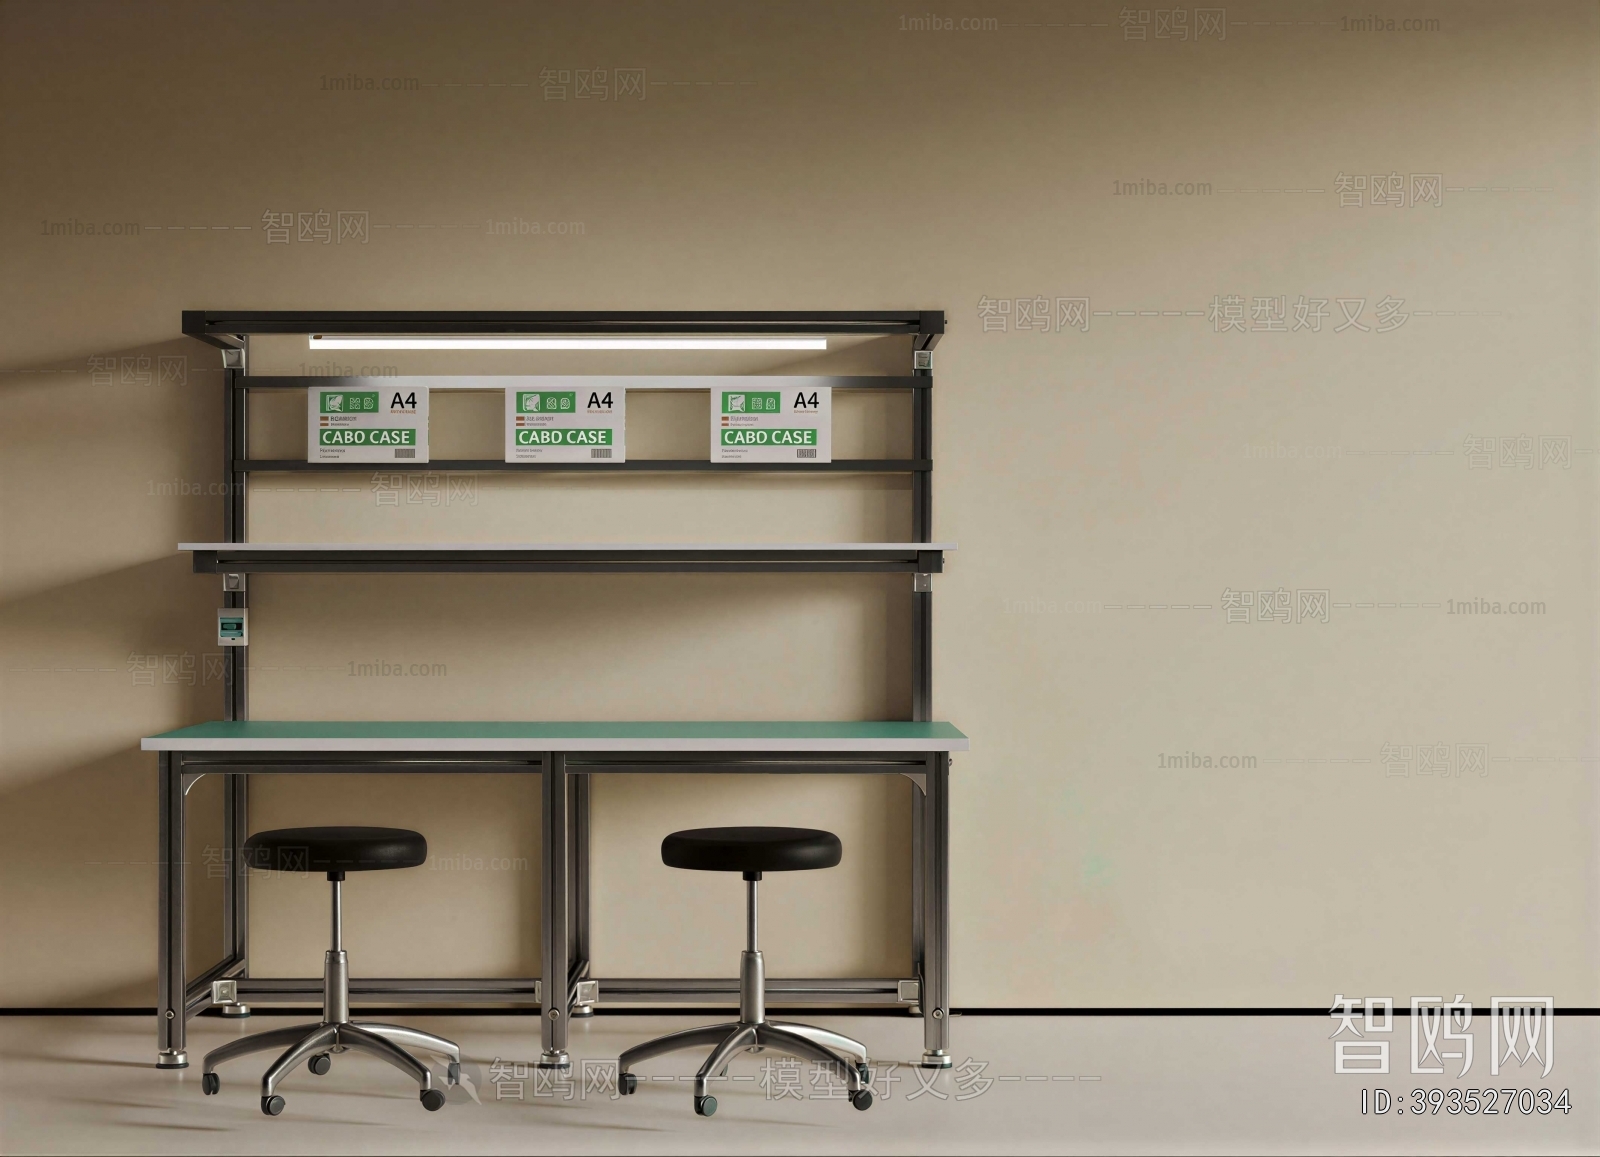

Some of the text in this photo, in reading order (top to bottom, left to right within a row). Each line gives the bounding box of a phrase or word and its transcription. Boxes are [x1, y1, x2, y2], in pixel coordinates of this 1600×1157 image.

[390, 392, 417, 409] A4
[587, 391, 613, 408] A4
[793, 391, 819, 408] A4
[322, 430, 410, 444] CABO CASE
[566, 430, 606, 444] CASE
[771, 430, 812, 444] CASE
